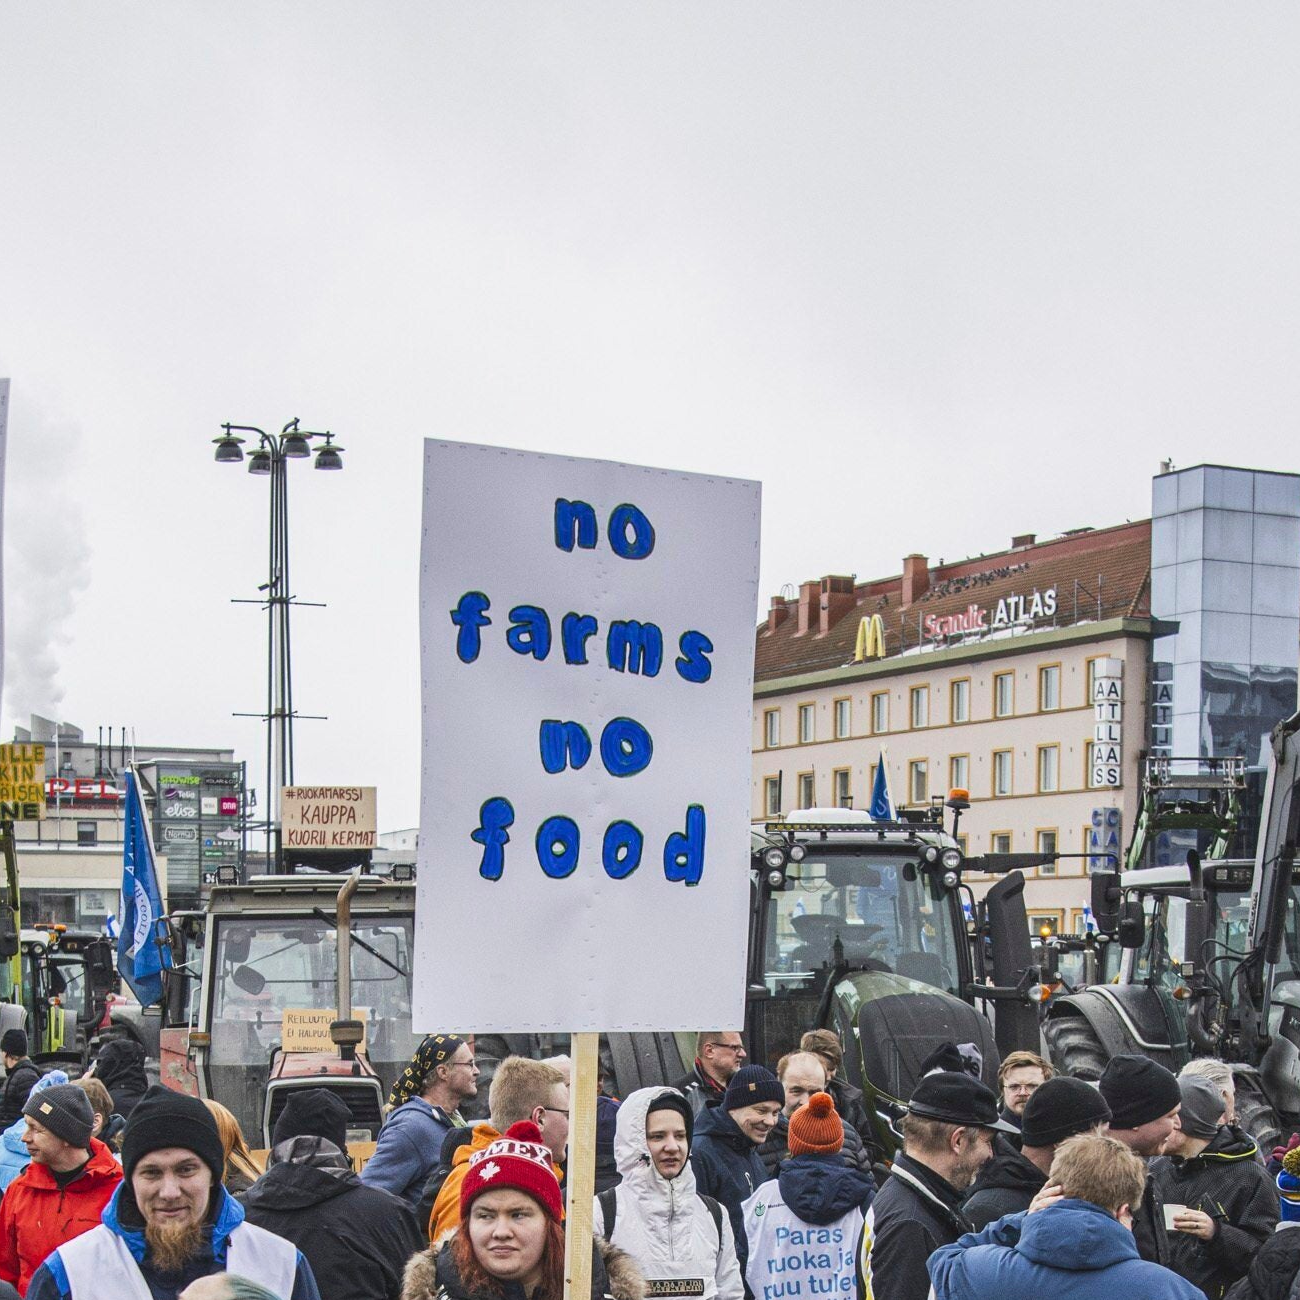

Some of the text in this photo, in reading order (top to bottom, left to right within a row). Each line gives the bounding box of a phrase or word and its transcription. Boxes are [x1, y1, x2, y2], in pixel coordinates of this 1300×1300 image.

[554, 498, 655, 559] no
[924, 589, 1057, 639] Scandic ATLAS
[450, 591, 713, 683] farms
[540, 716, 654, 778] no
[1106, 682, 1120, 785] ATLAS
[178, 790, 195, 799] Telia
[285, 787, 363, 801] #RUOKAMARSSI
[164, 803, 196, 817] elisa
[301, 804, 356, 824] KAUPPA
[288, 829, 376, 846] KUORII KERMAT
[471, 796, 706, 887] food
[775, 1226, 844, 1247] Paras
[767, 1247, 854, 1274] ruoka ja
